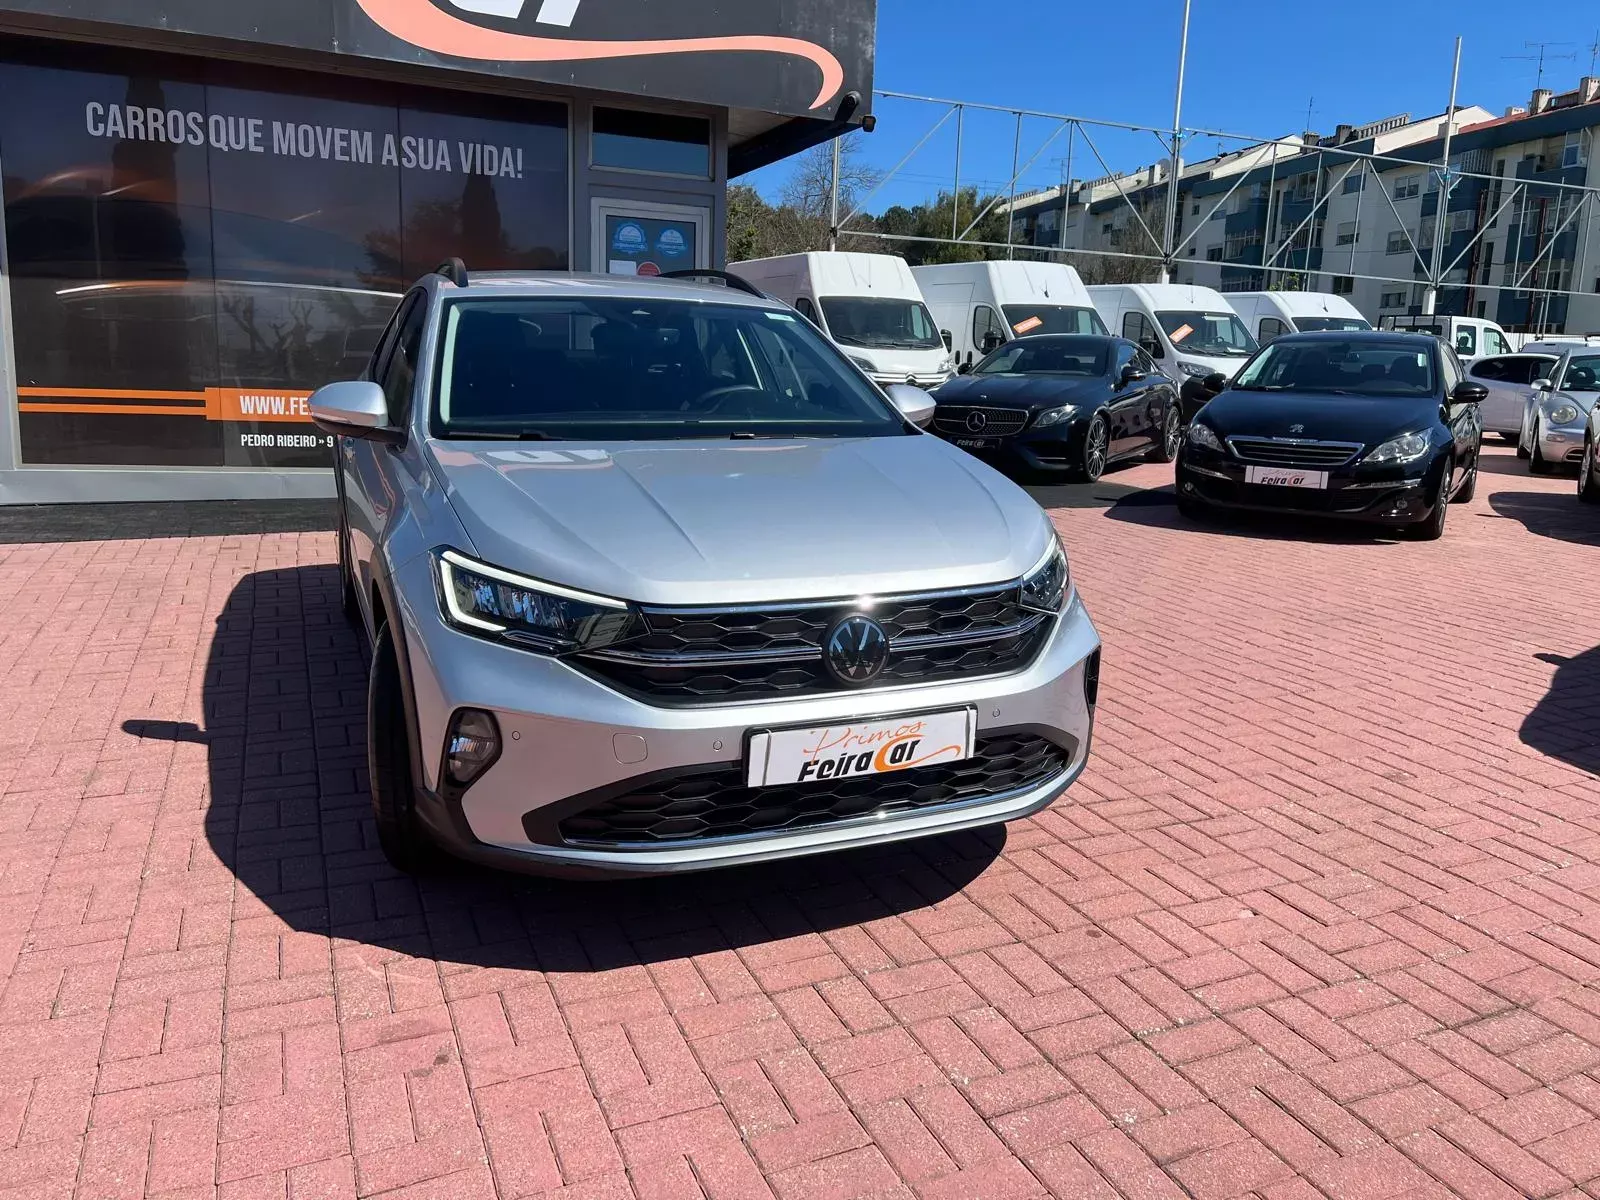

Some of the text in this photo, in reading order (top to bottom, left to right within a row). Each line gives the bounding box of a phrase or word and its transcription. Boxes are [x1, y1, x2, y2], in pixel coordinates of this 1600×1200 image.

[85, 101, 523, 178] CARROS QUE MOVEM A SUA VIDA!
[240, 395, 313, 416] WWW.FE
[241, 434, 275, 447] PEDRO
[276, 435, 317, 448] RIBEIRO
[803, 721, 928, 767] Primos
